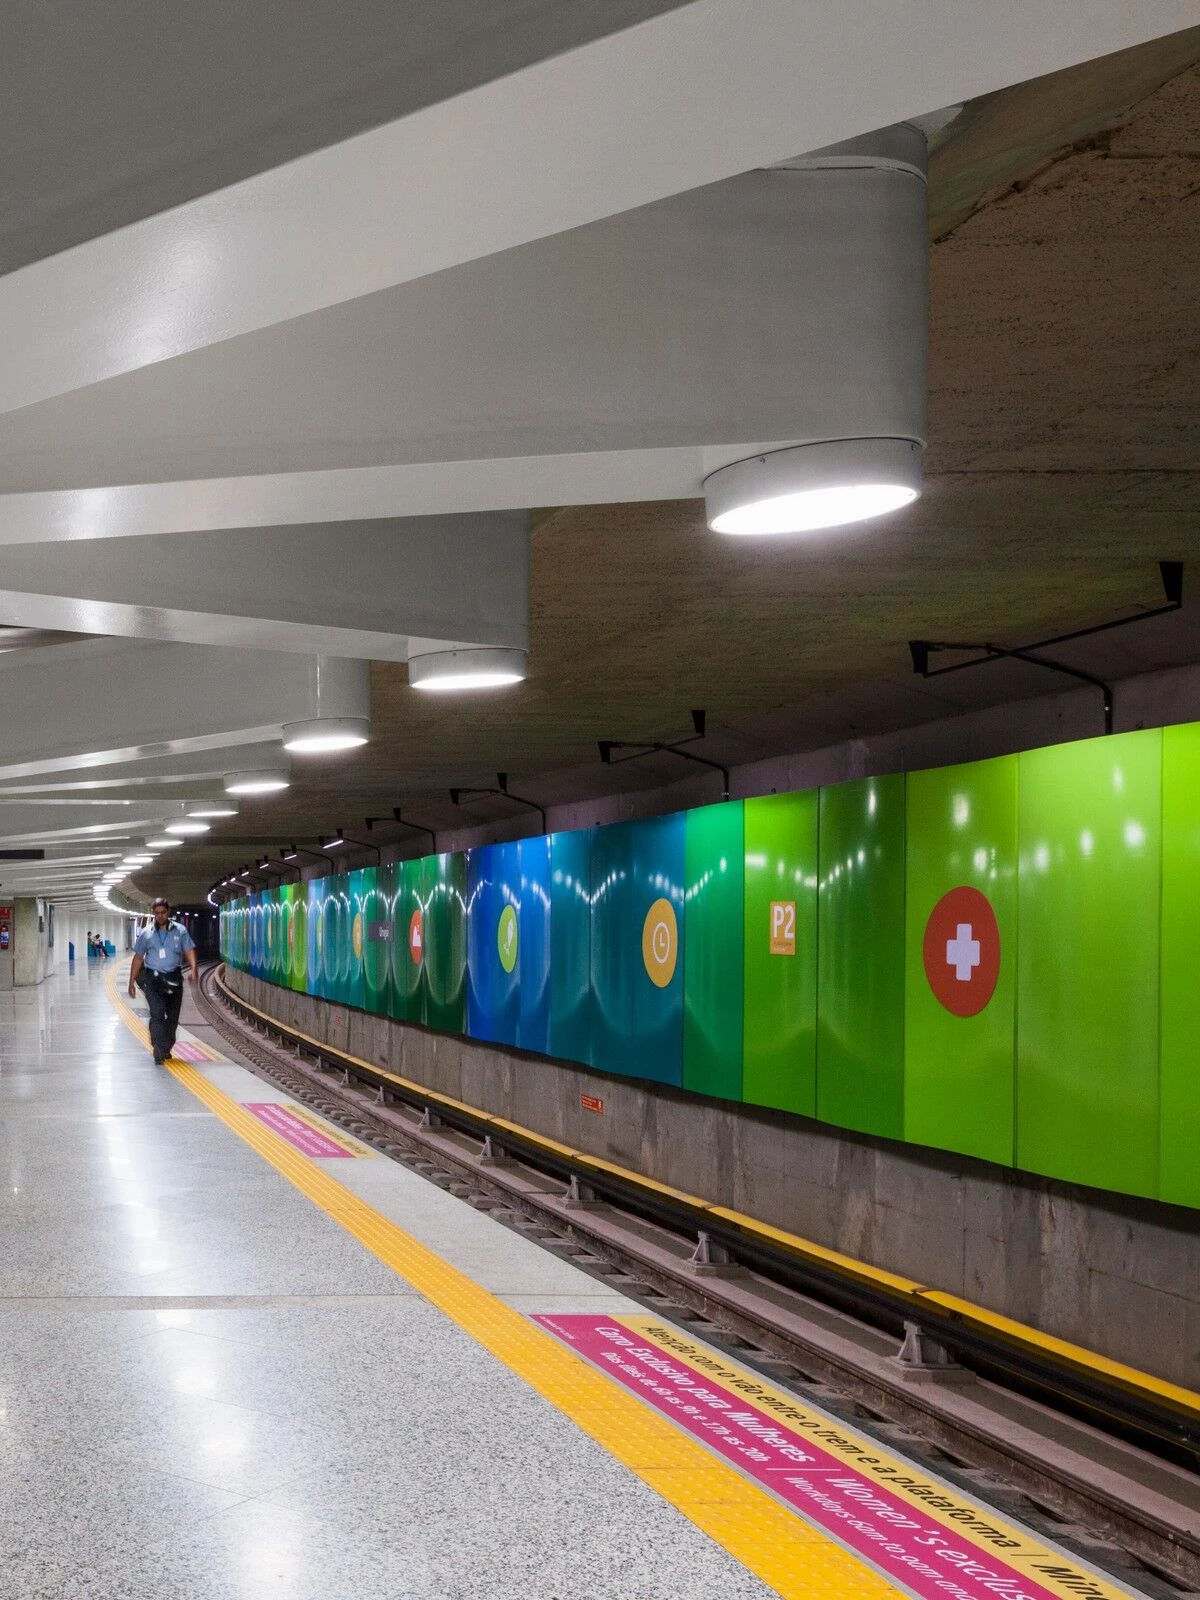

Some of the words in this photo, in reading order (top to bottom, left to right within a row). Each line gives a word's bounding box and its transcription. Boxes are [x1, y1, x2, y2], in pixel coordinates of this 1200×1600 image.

[773, 904, 795, 939] P2
[640, 1326, 696, 1354] Atenção
[600, 1352, 625, 1364] Dias
[688, 1355, 725, 1371] com
[639, 1378, 658, 1388] de
[729, 1379, 764, 1395] vão
[651, 1387, 675, 1396] 6h
[675, 1405, 702, 1414] 9h
[756, 1395, 807, 1420] entre
[701, 1422, 732, 1435] 17h
[798, 1421, 821, 1429] o
[594, 1326, 635, 1346] Carro
[625, 1347, 696, 1386] Exclusivo
[678, 1387, 733, 1409] para
[721, 1411, 817, 1463] Mulheres
[824, 1477, 949, 1546] Women's
[812, 1429, 865, 1455] trem
[736, 1446, 772, 1462] 20h
[856, 1455, 881, 1465] e
[871, 1465, 897, 1475] a
[784, 1477, 856, 1518] Workdays
[880, 1476, 1022, 1548] plataforma
[846, 1519, 889, 1540] 6am
[879, 1542, 907, 1554] to
[888, 1553, 945, 1579] 9am
[1030, 1563, 1111, 1600] Min
